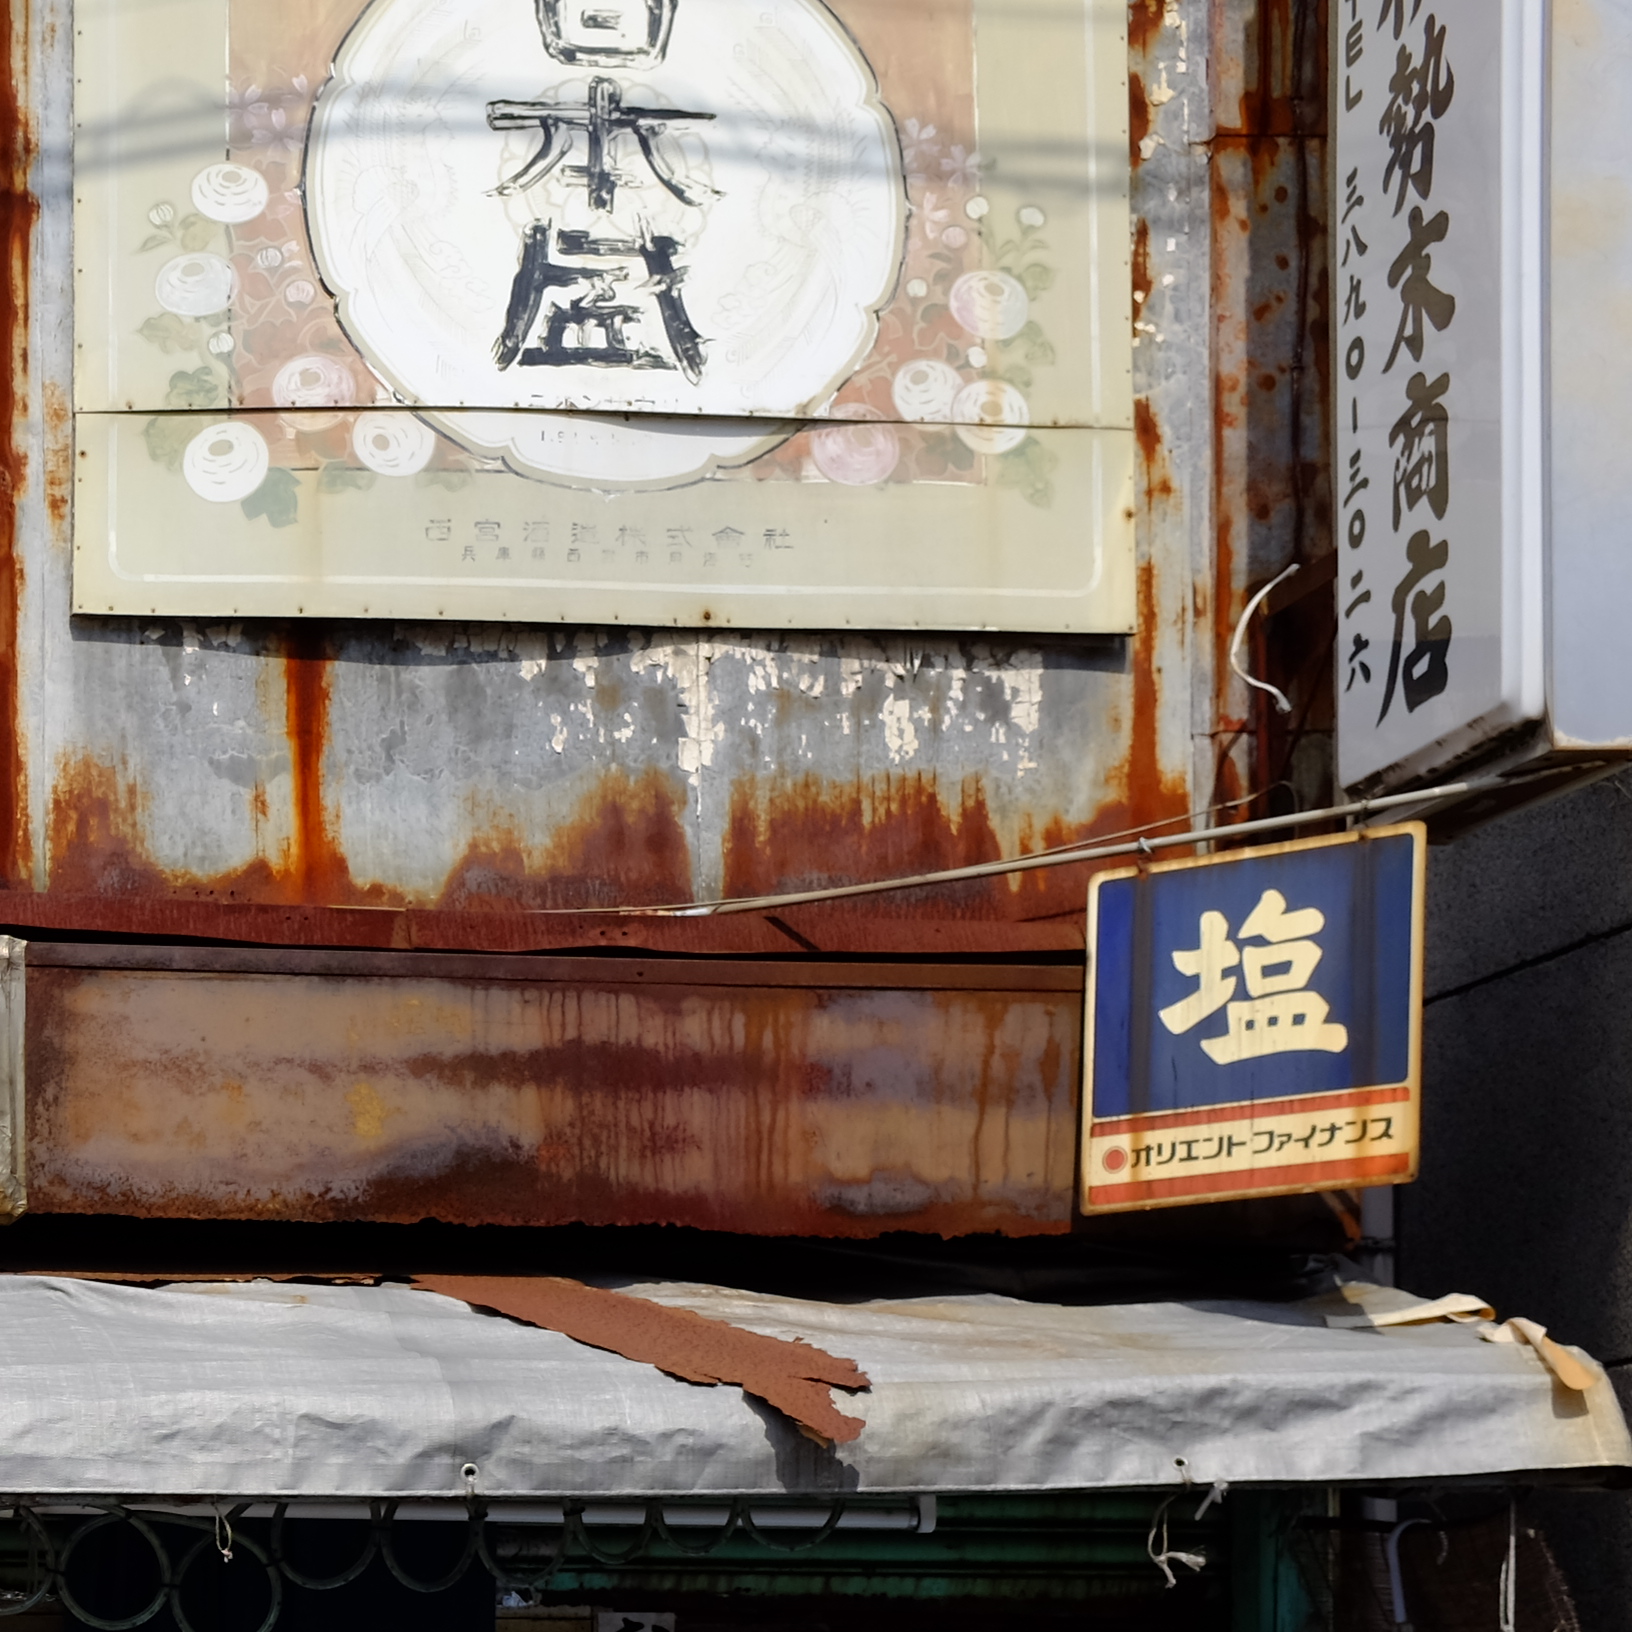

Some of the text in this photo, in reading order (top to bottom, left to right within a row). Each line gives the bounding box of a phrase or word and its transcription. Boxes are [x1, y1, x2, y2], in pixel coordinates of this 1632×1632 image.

[1158, 888, 1349, 1066] 塩
[1130, 1115, 1395, 1169] オリエントファイナンス
